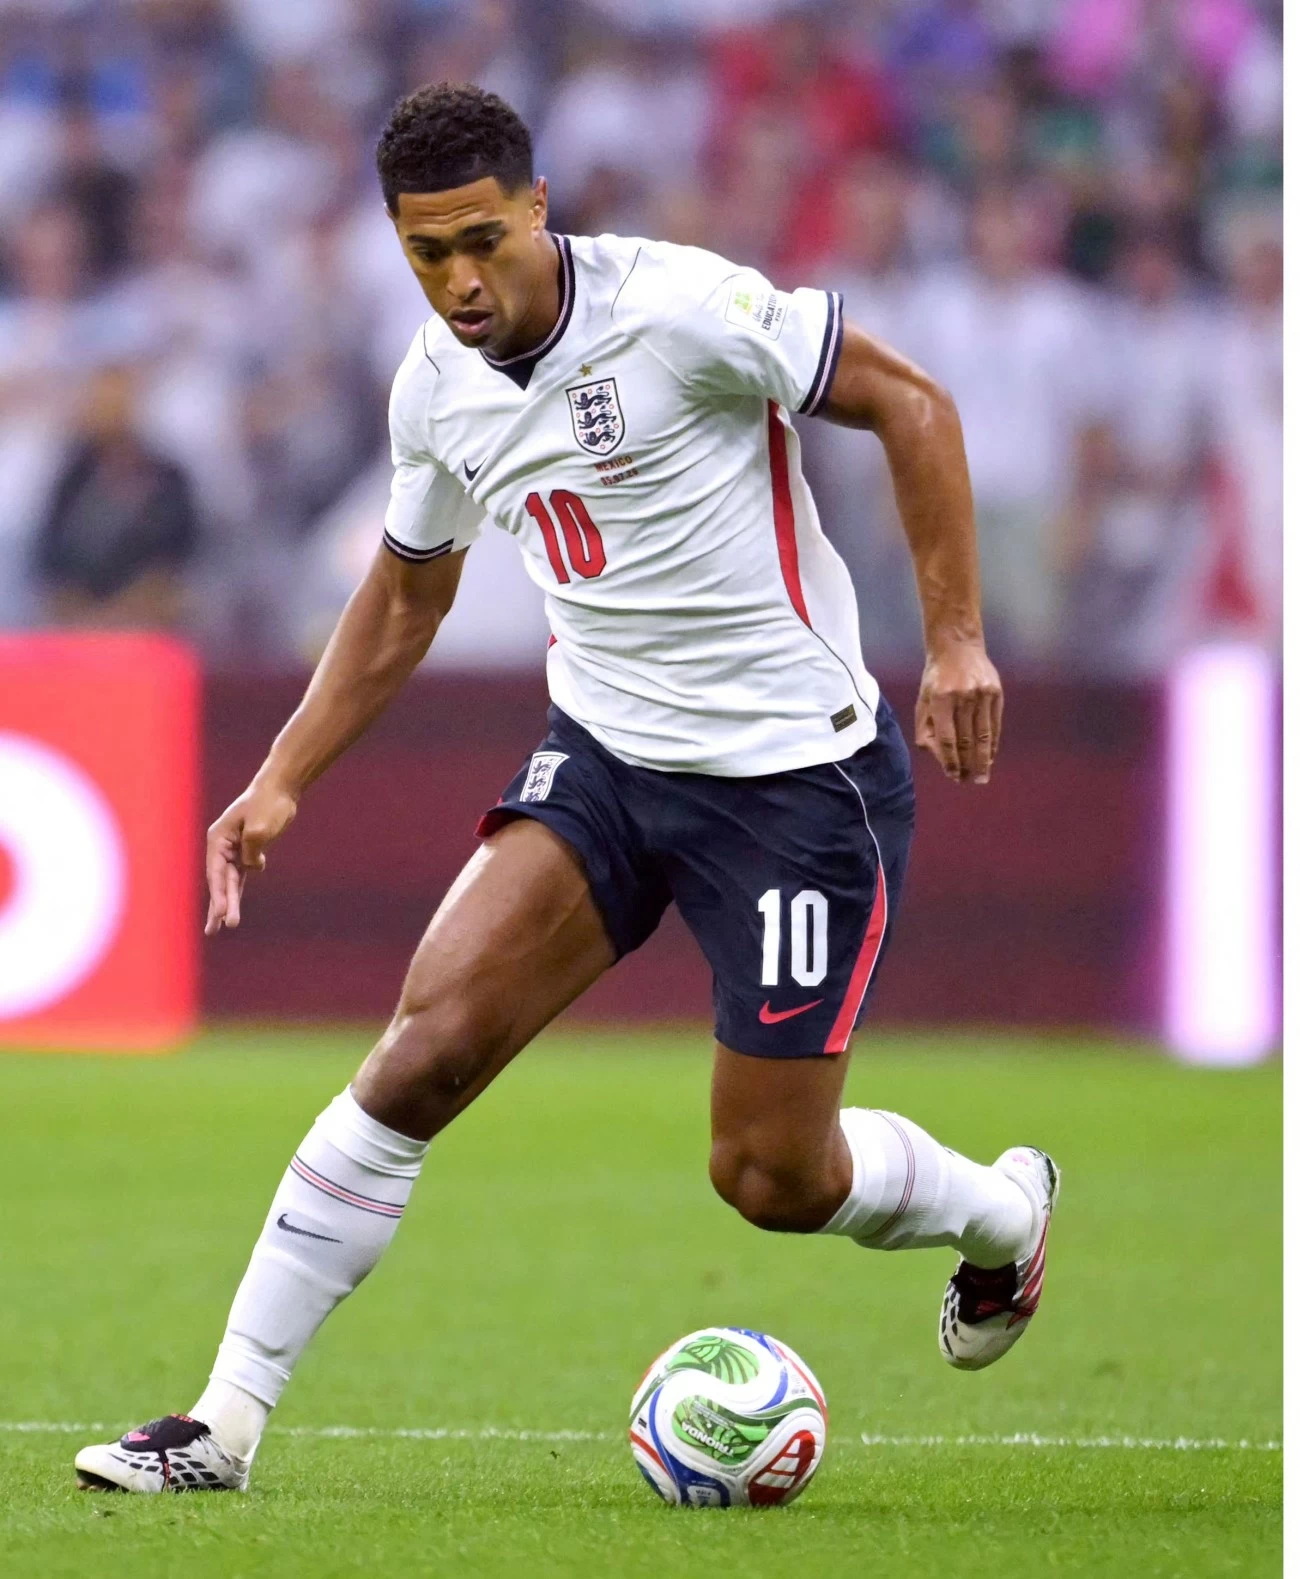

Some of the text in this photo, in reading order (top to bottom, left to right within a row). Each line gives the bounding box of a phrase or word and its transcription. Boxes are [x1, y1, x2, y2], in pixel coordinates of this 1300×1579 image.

[594, 455, 633, 472] MEXICO
[525, 489, 607, 584] 10
[758, 889, 828, 988] 10
[682, 1421, 734, 1457] TRIONDA
